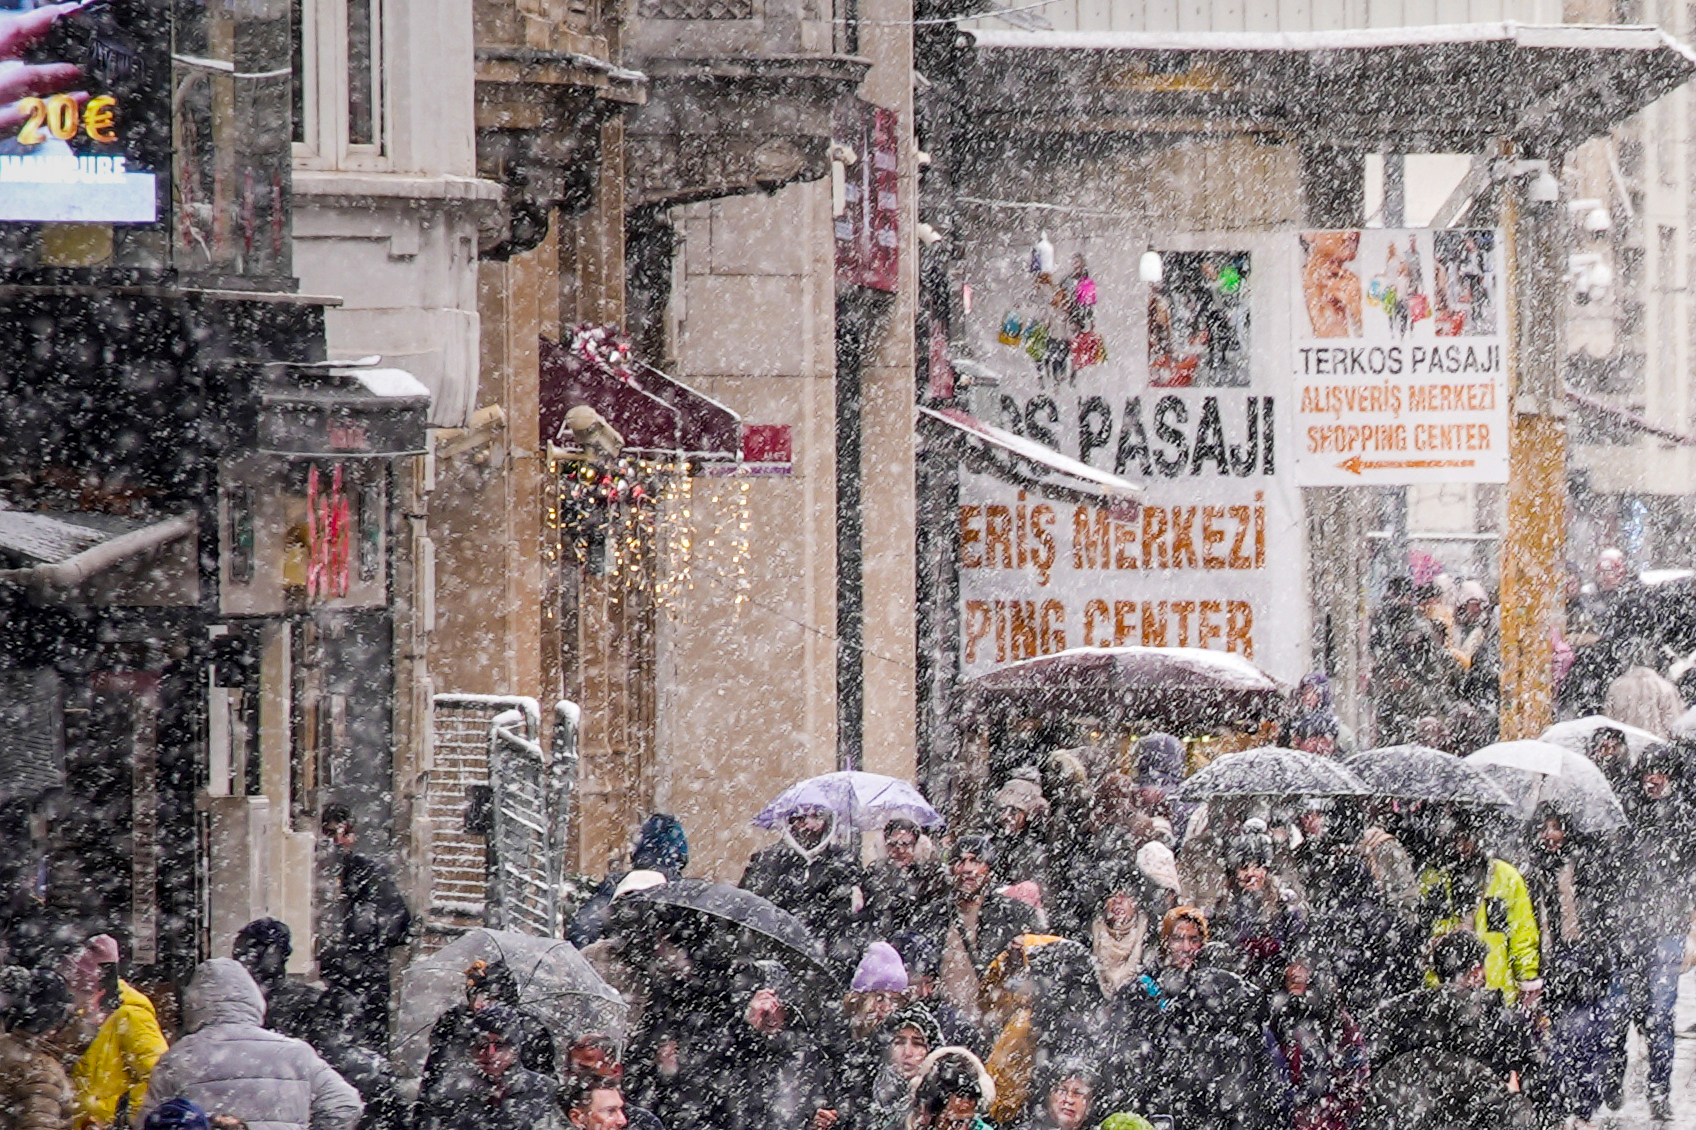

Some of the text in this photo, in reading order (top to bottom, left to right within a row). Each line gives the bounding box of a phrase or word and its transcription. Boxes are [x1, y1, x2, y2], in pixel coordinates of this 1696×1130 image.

[1300, 345, 1500, 375] TERKOS PASAJI
[1408, 377, 1496, 412] MERKEZİ
[1079, 396, 1275, 478] PASAJI
[1307, 424, 1491, 453] SHOPPING CENTER
[1073, 489, 1266, 570] MERKEZİ
[965, 599, 1253, 663] PING CENTER
